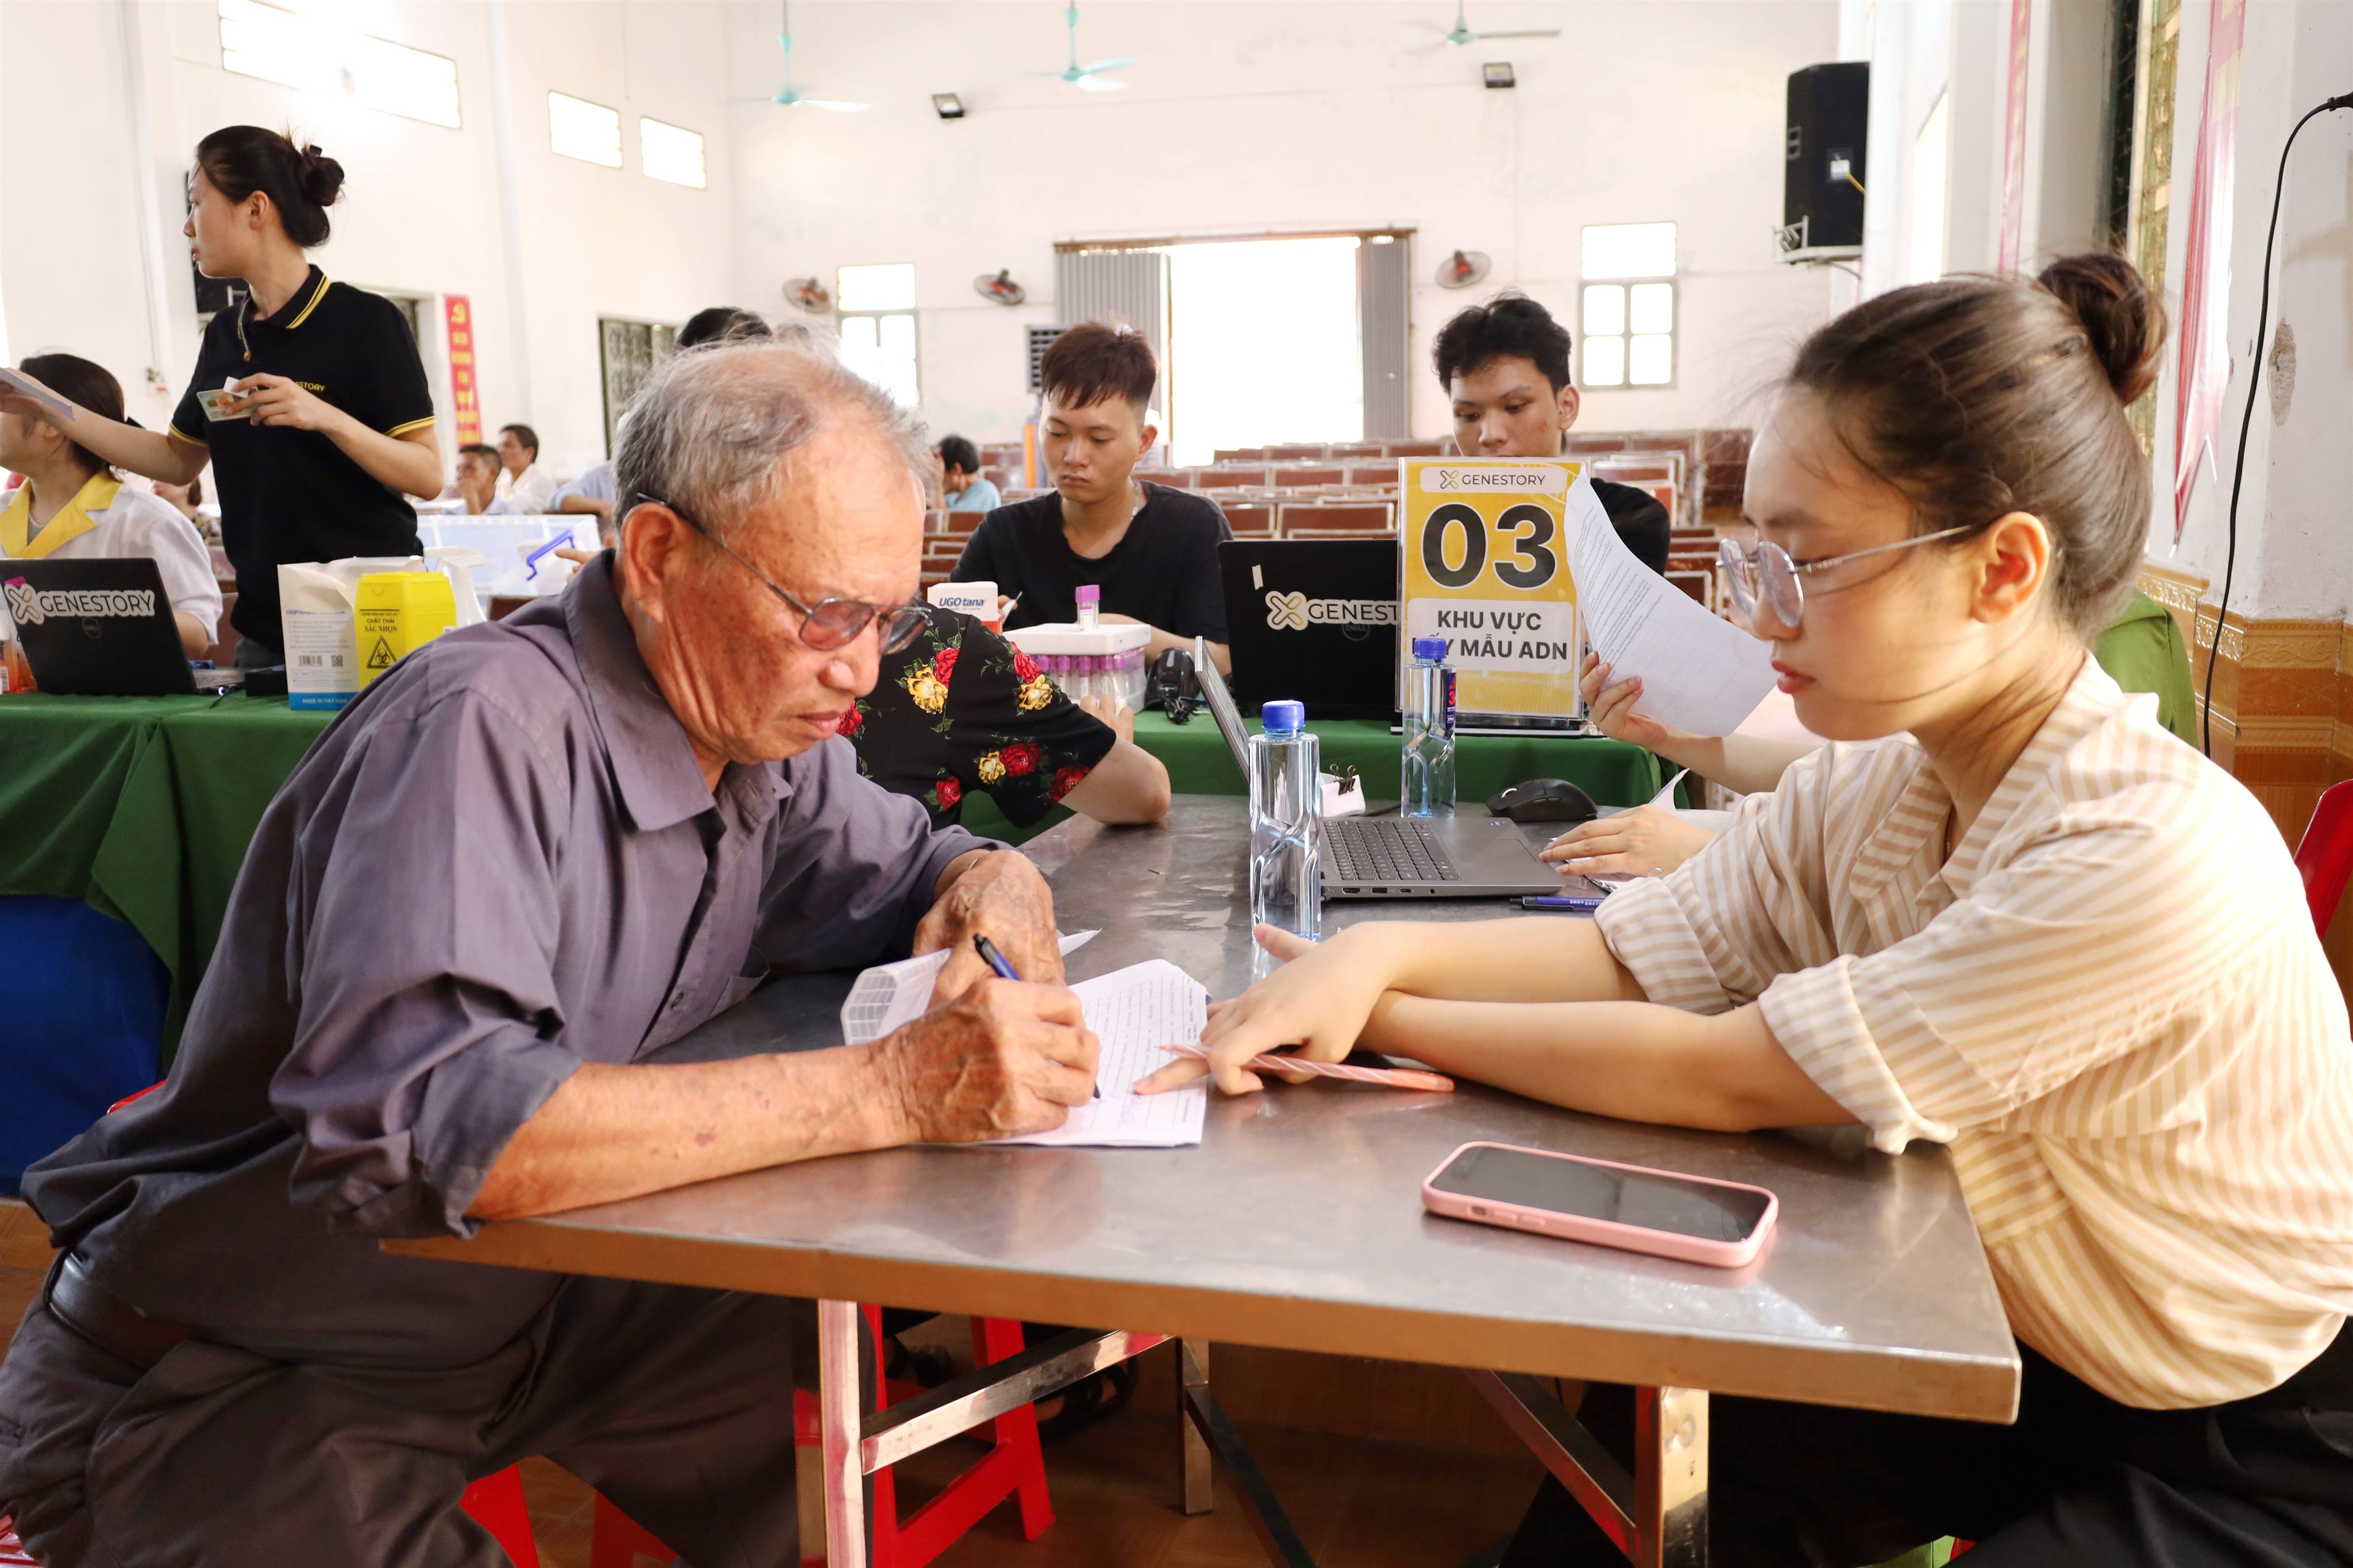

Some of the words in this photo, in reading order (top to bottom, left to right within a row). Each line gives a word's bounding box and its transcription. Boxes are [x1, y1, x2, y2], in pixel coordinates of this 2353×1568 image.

[1461, 474, 1546, 485] GENESTORY
[1422, 502, 1557, 589] 03
[39, 594, 151, 612] GENESTORY
[939, 597, 962, 607] UGO
[963, 598, 984, 607] tana
[1437, 610, 1484, 629] KHU
[1490, 611, 1542, 635] VỰC
[1461, 634, 1513, 658] MẪU
[1518, 641, 1567, 660] ADN
